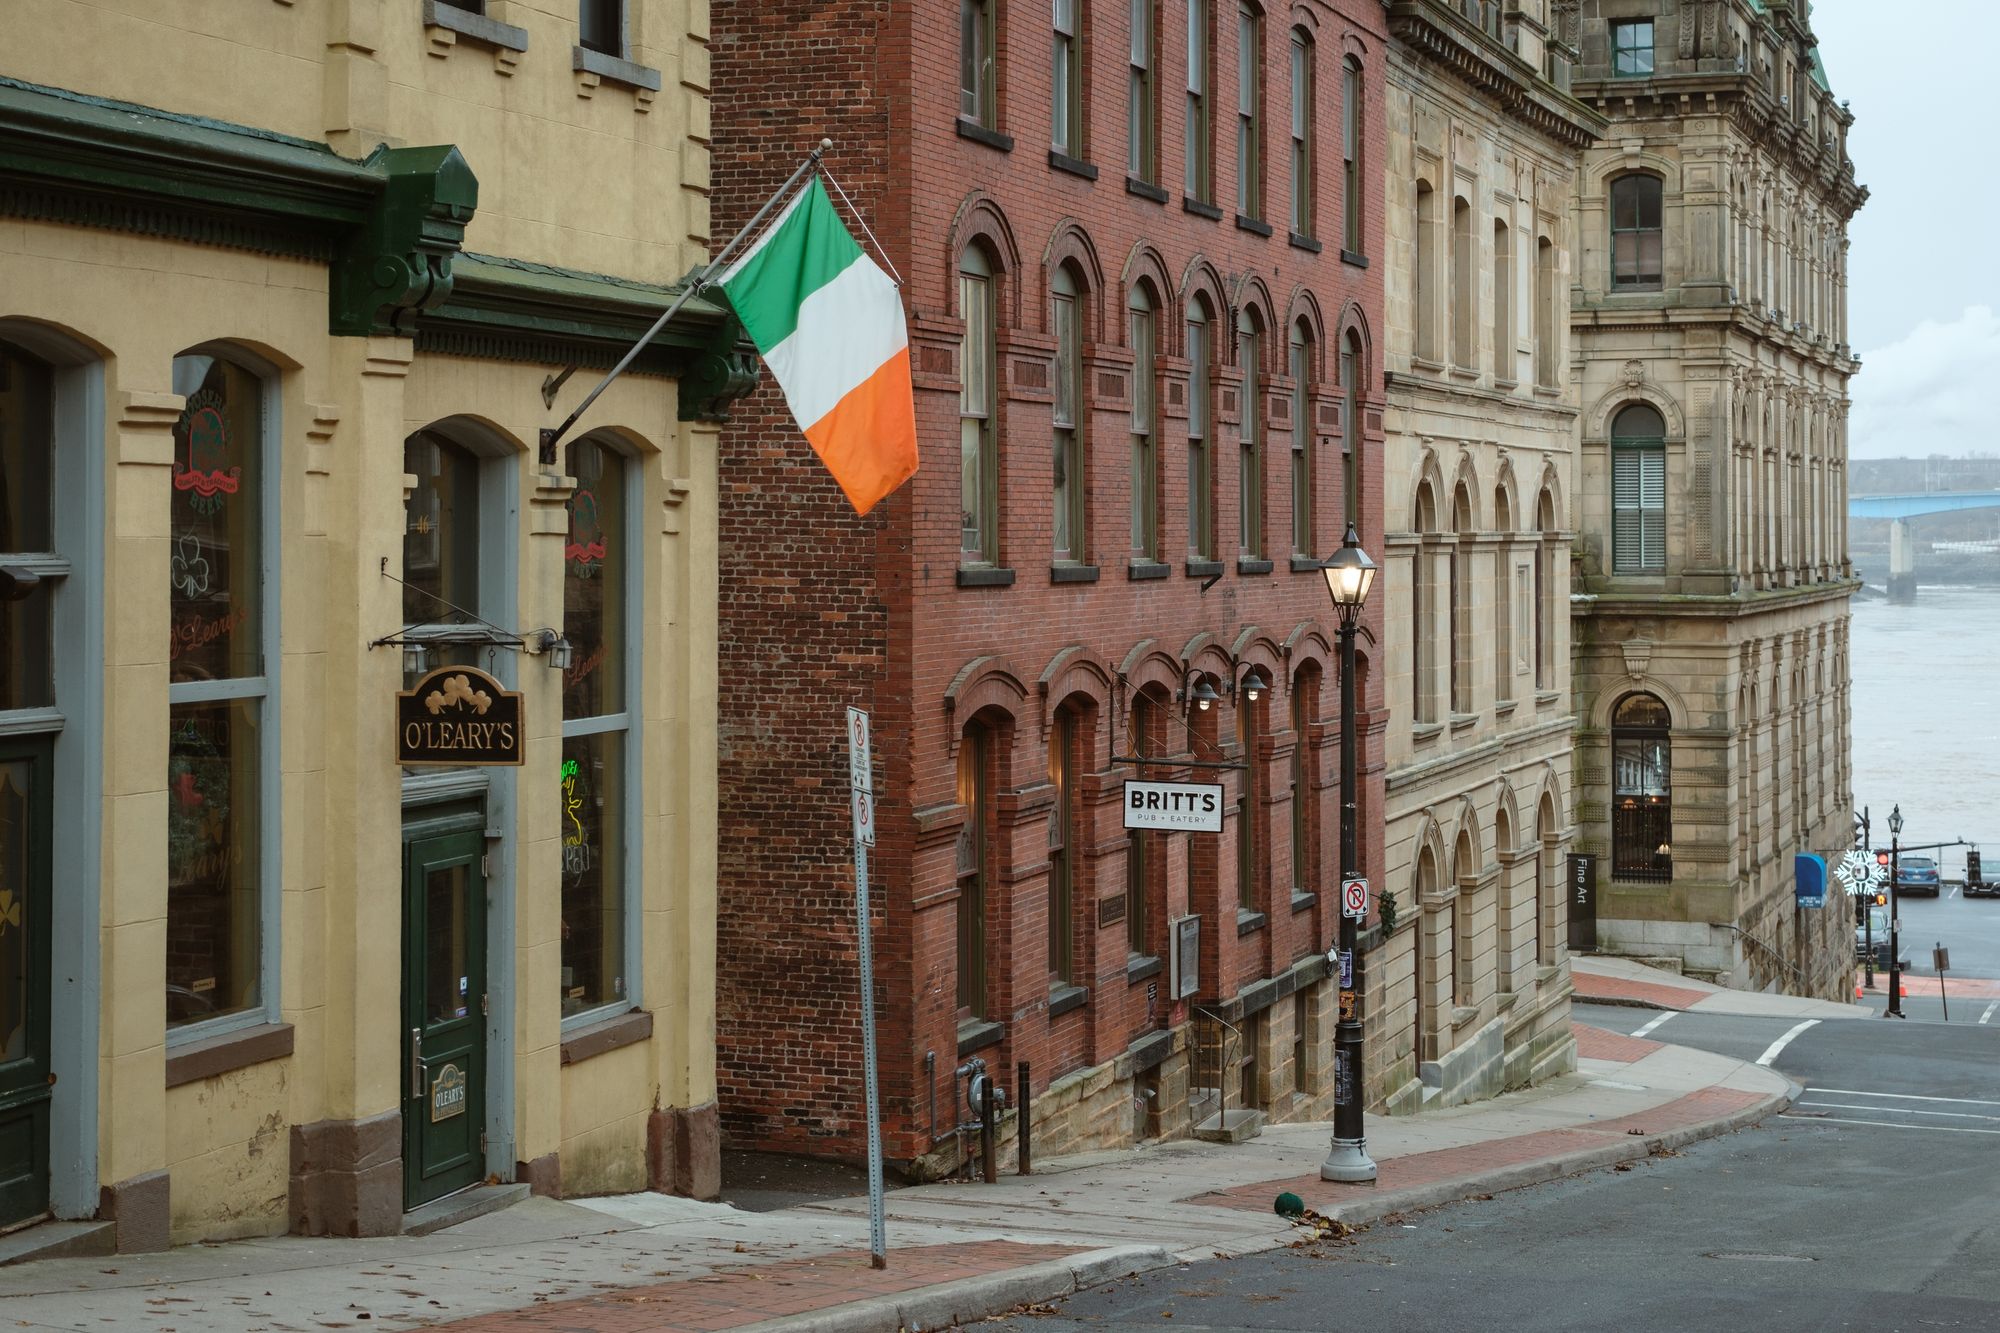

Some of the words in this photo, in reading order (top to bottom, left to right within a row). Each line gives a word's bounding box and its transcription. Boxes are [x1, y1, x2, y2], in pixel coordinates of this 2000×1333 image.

[189, 491, 224, 516] BEER
[417, 514, 429, 534] 46
[405, 722, 514, 750] O'LEARY'S
[1131, 790, 1215, 812] BRITT'S
[1137, 813, 1156, 821] PUB
[1170, 815, 1206, 823] EATERY
[1577, 858, 1588, 883] Fine
[1577, 886, 1588, 904] Art
